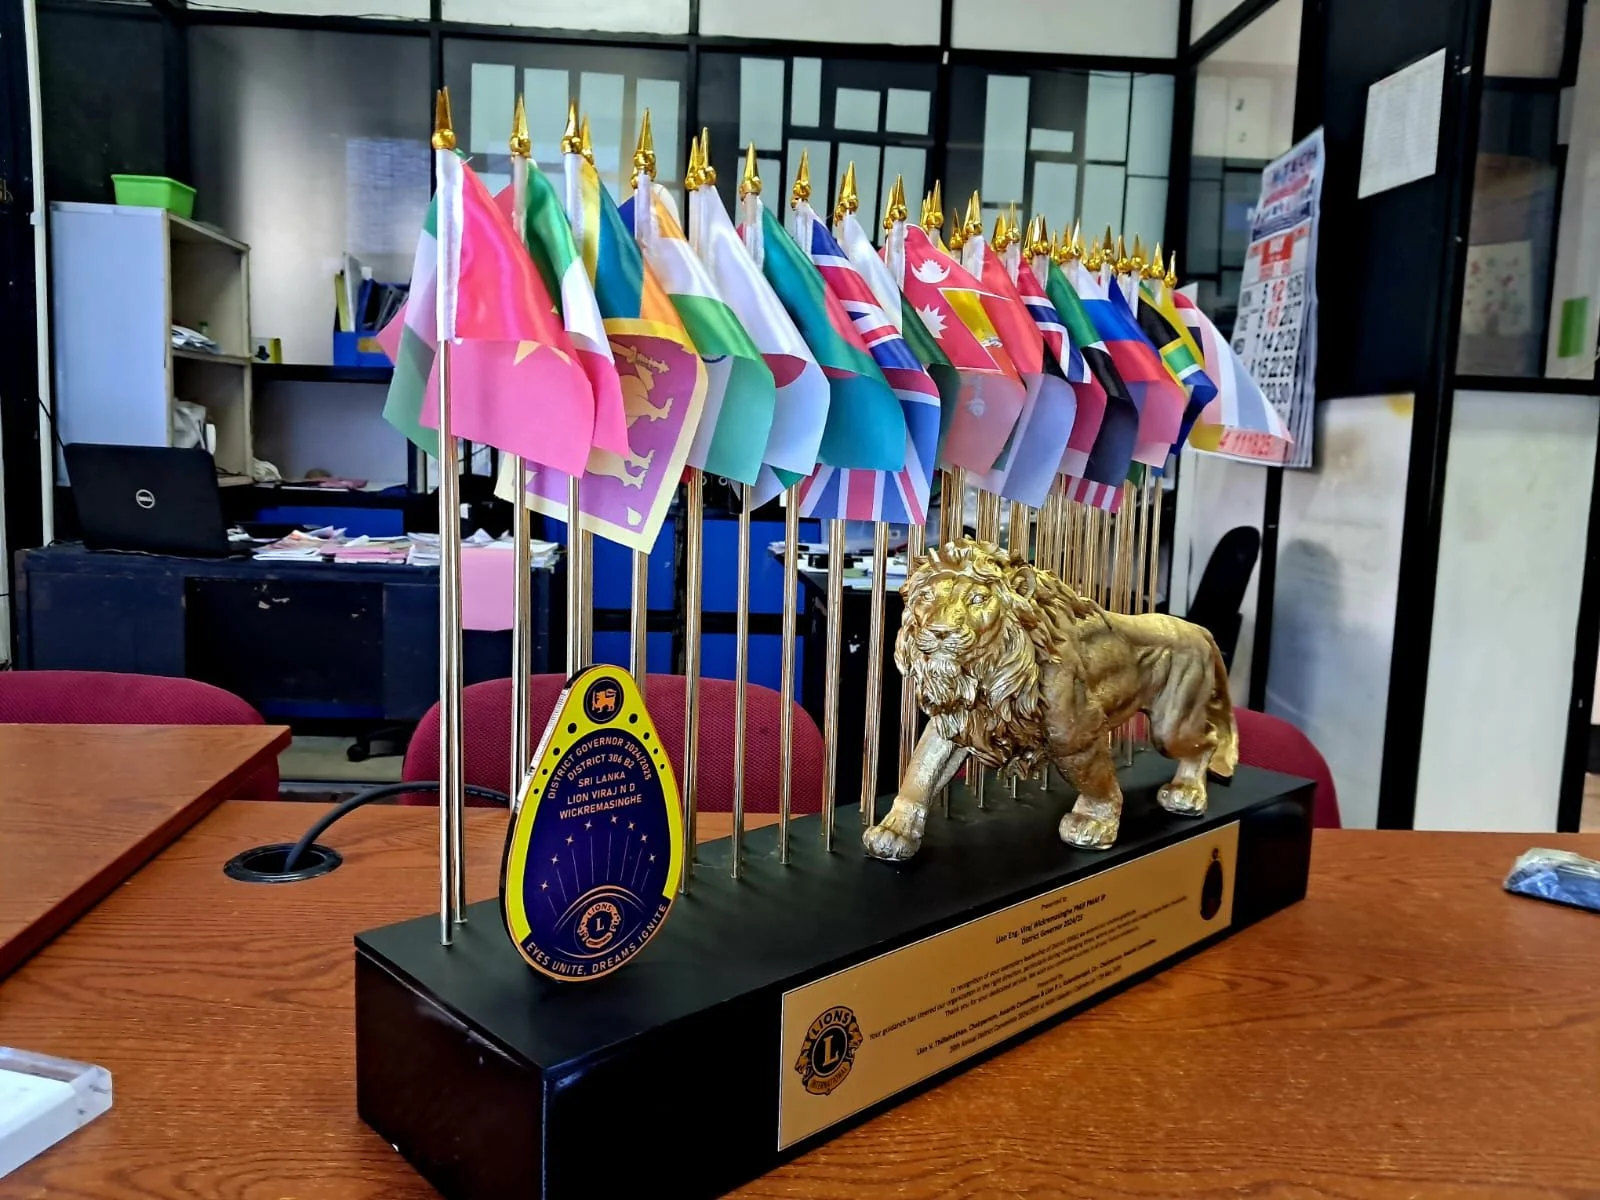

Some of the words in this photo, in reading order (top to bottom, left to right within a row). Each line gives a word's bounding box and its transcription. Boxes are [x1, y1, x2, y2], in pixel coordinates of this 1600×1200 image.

[548, 754, 575, 798] DISTRICT
[575, 737, 624, 757] GOVERNOR
[624, 742, 652, 780] 2024/2025
[567, 754, 606, 781] DISTRICT
[608, 754, 623, 763] 306
[623, 758, 635, 769] B2
[578, 777, 593, 788] SRI
[596, 771, 626, 784] LANKA
[567, 793, 589, 805] LION
[591, 787, 617, 800] VIRAJ
[620, 785, 627, 794] N
[629, 783, 636, 792] D
[559, 794, 642, 820] WICKREMASINGHE
[587, 903, 613, 916] LIONS
[596, 918, 605, 932] L
[995, 934, 1007, 944] Lion
[1007, 930, 1019, 939] Eng.
[1019, 923, 1032, 933] Viraj
[1021, 932, 1039, 945] District
[1039, 923, 1062, 937] Governor
[526, 941, 550, 966] EYES
[552, 961, 587, 976] UNITE,
[592, 942, 636, 974] DREAMS
[638, 903, 667, 943] IGNITE
[956, 975, 983, 990] recognition
[944, 1006, 959, 1016] Thank
[812, 1010, 850, 1035] LIONS
[869, 1030, 881, 1039] Your
[881, 1019, 906, 1036] guidance
[822, 1035, 840, 1067] L
[916, 1046, 928, 1055] Lion
